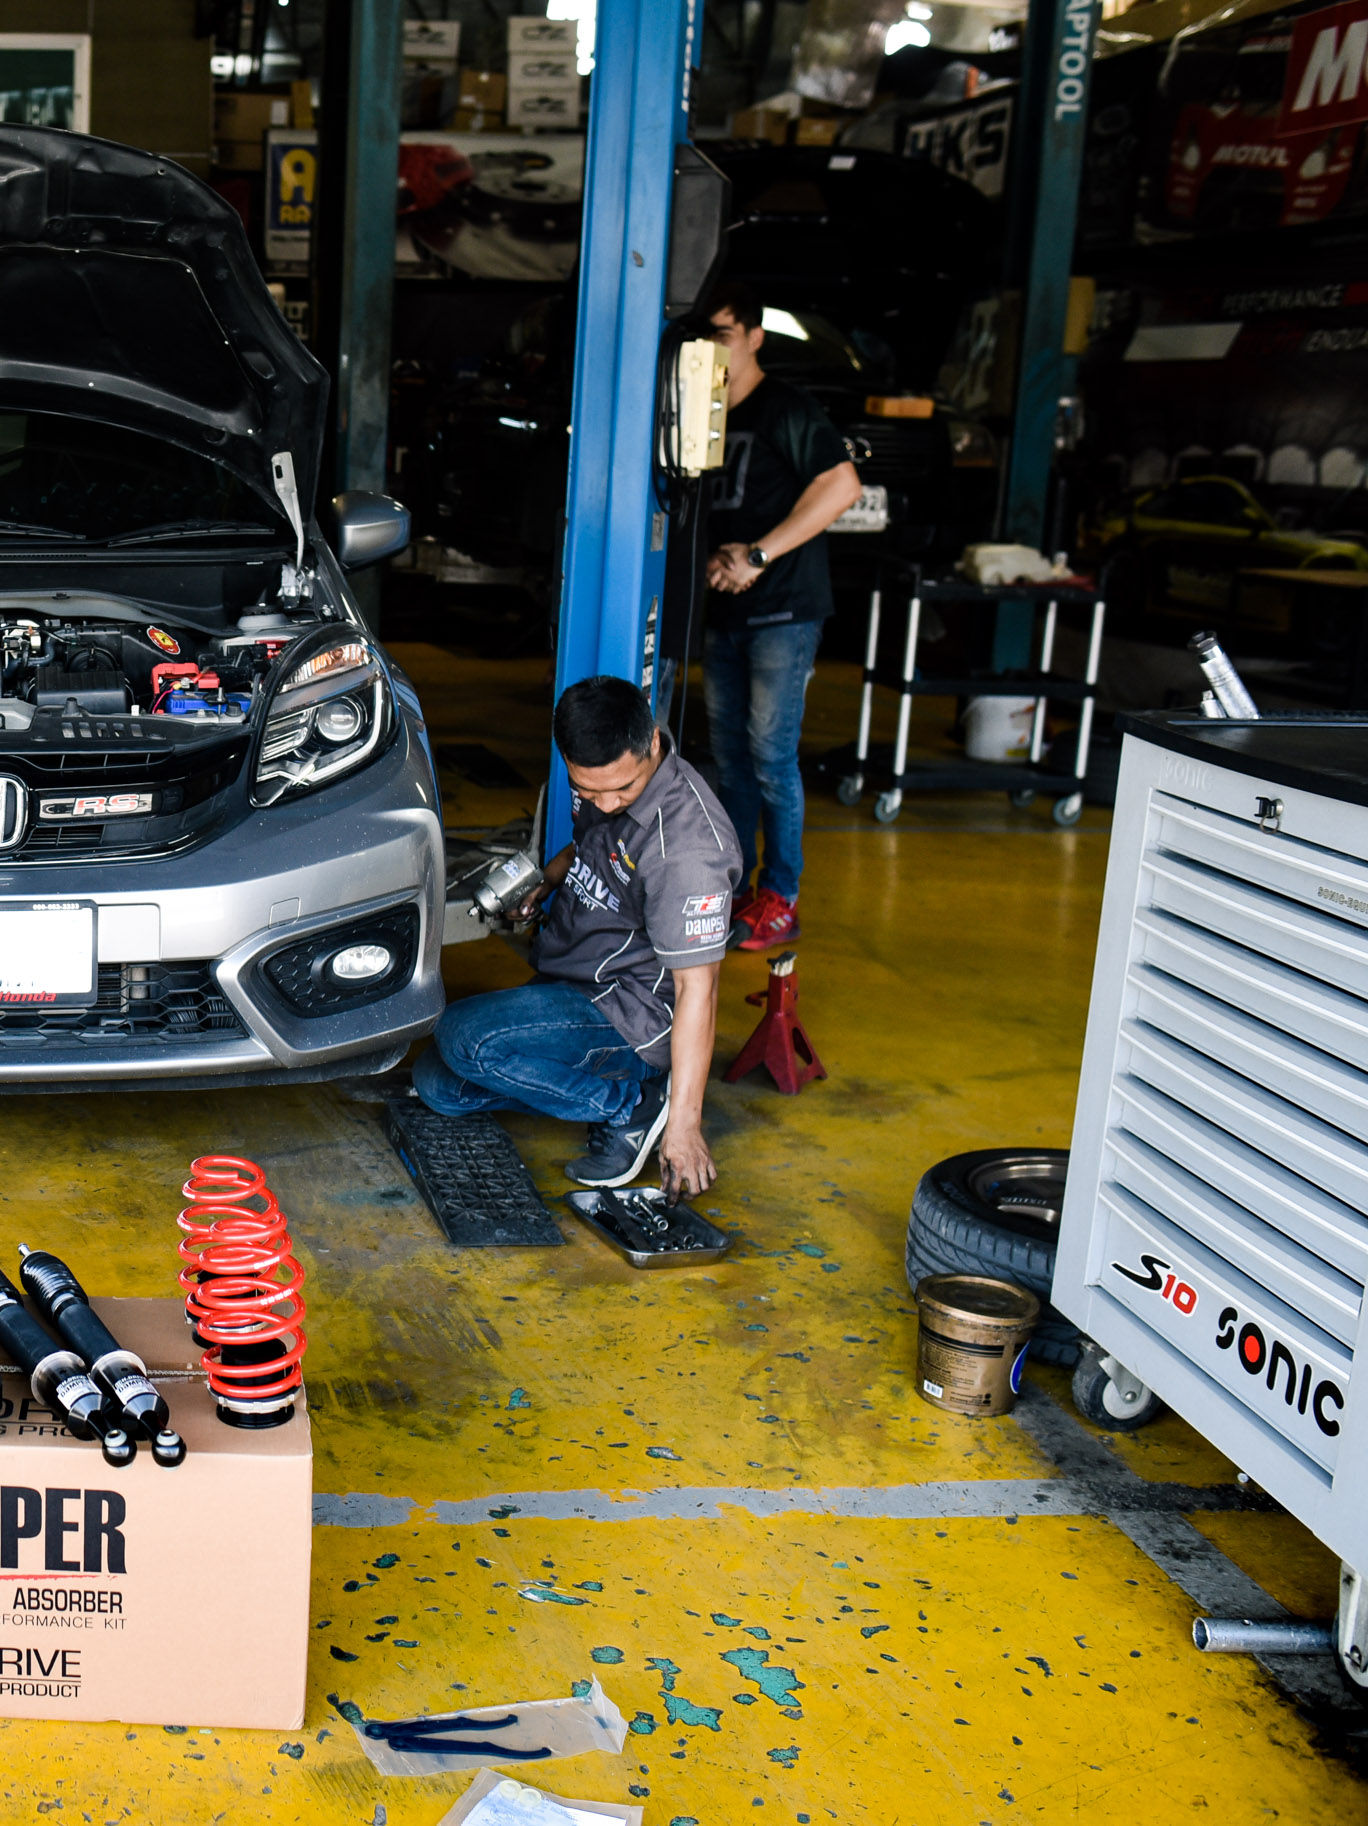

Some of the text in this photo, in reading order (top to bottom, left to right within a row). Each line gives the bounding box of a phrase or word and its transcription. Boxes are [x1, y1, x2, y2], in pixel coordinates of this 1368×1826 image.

[73, 794, 140, 816] RS
[1112, 1254, 1197, 1315] S10
[13, 1587, 123, 1614] ABSORBER
[104, 1617, 127, 1630] KIT
[0, 1682, 81, 1698] PRODUCT
